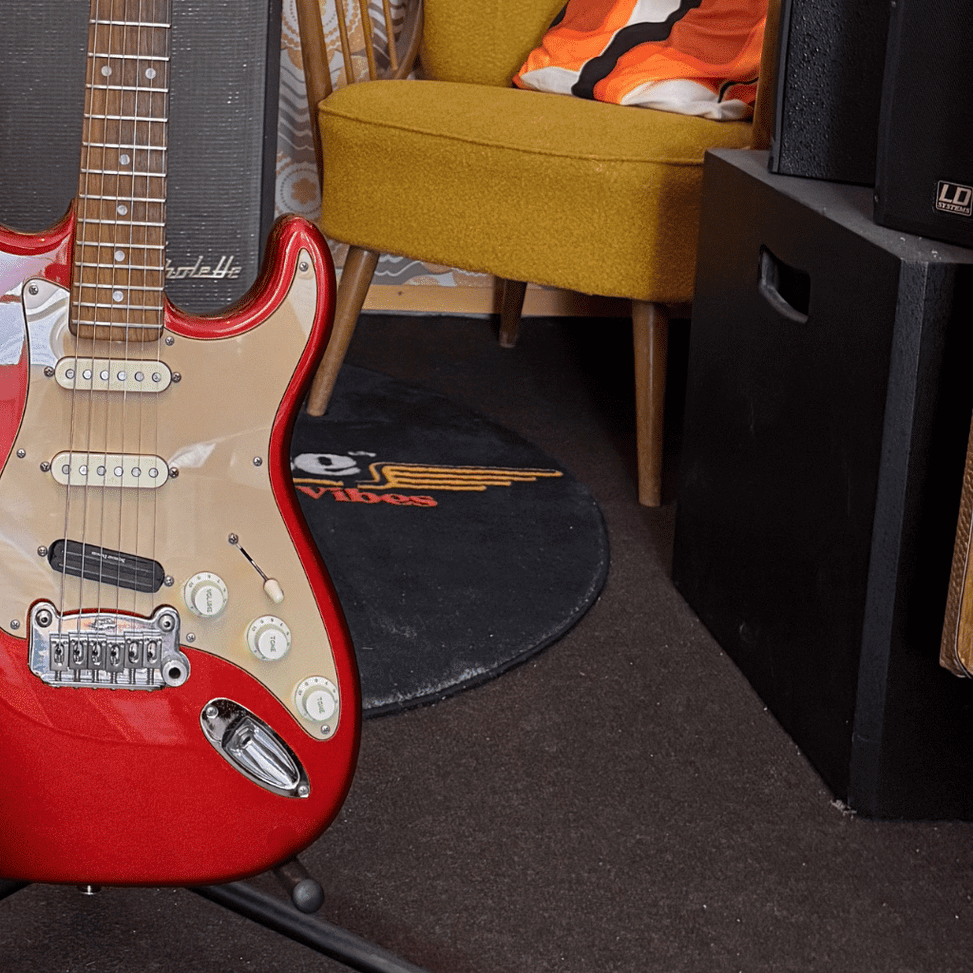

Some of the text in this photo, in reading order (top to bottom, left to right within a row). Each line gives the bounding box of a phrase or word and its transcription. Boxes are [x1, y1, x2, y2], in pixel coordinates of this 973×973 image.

[938, 183, 972, 207] LD
[294, 485, 438, 507] Vibes
[205, 588, 213, 613] VOLUME
